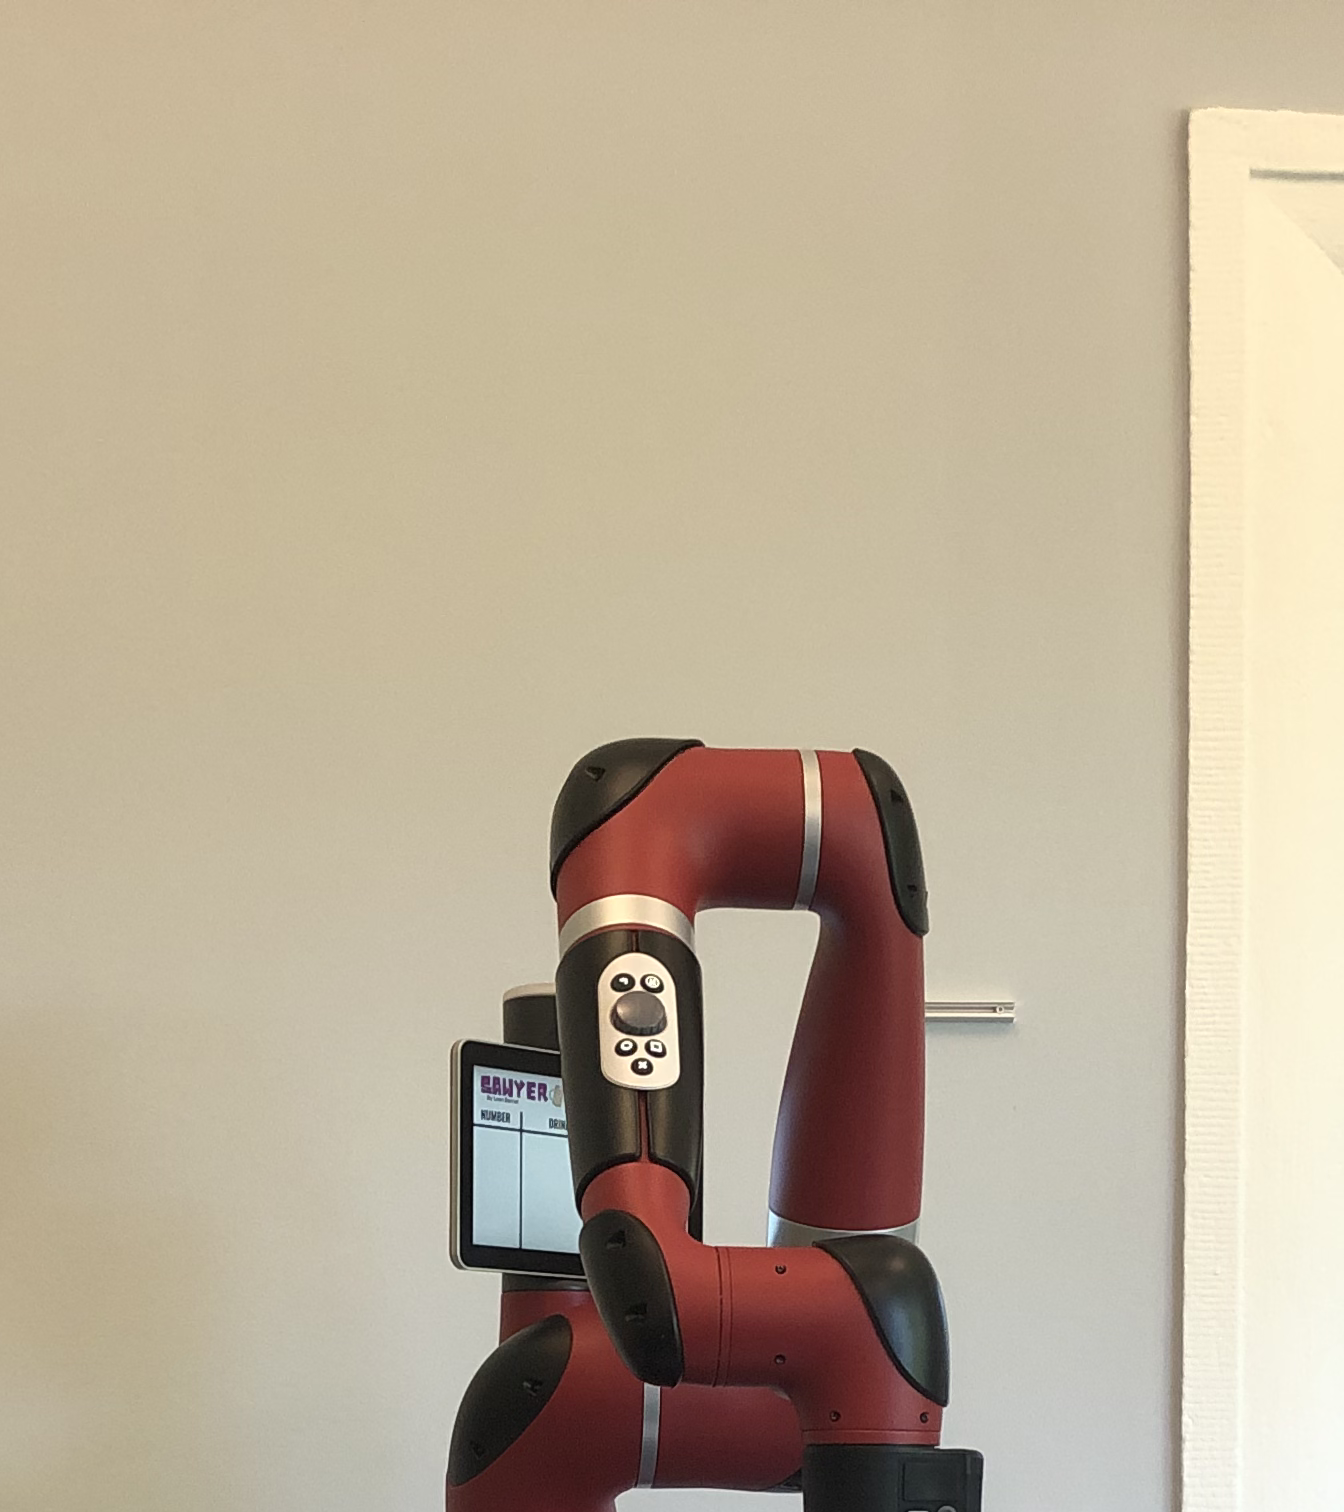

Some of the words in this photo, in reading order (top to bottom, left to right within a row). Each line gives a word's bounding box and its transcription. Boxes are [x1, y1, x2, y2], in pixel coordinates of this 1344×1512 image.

[480, 1075, 549, 1102] SAWYER
[480, 1109, 511, 1123] NUMBER
[548, 1117, 568, 1130] DRIN
